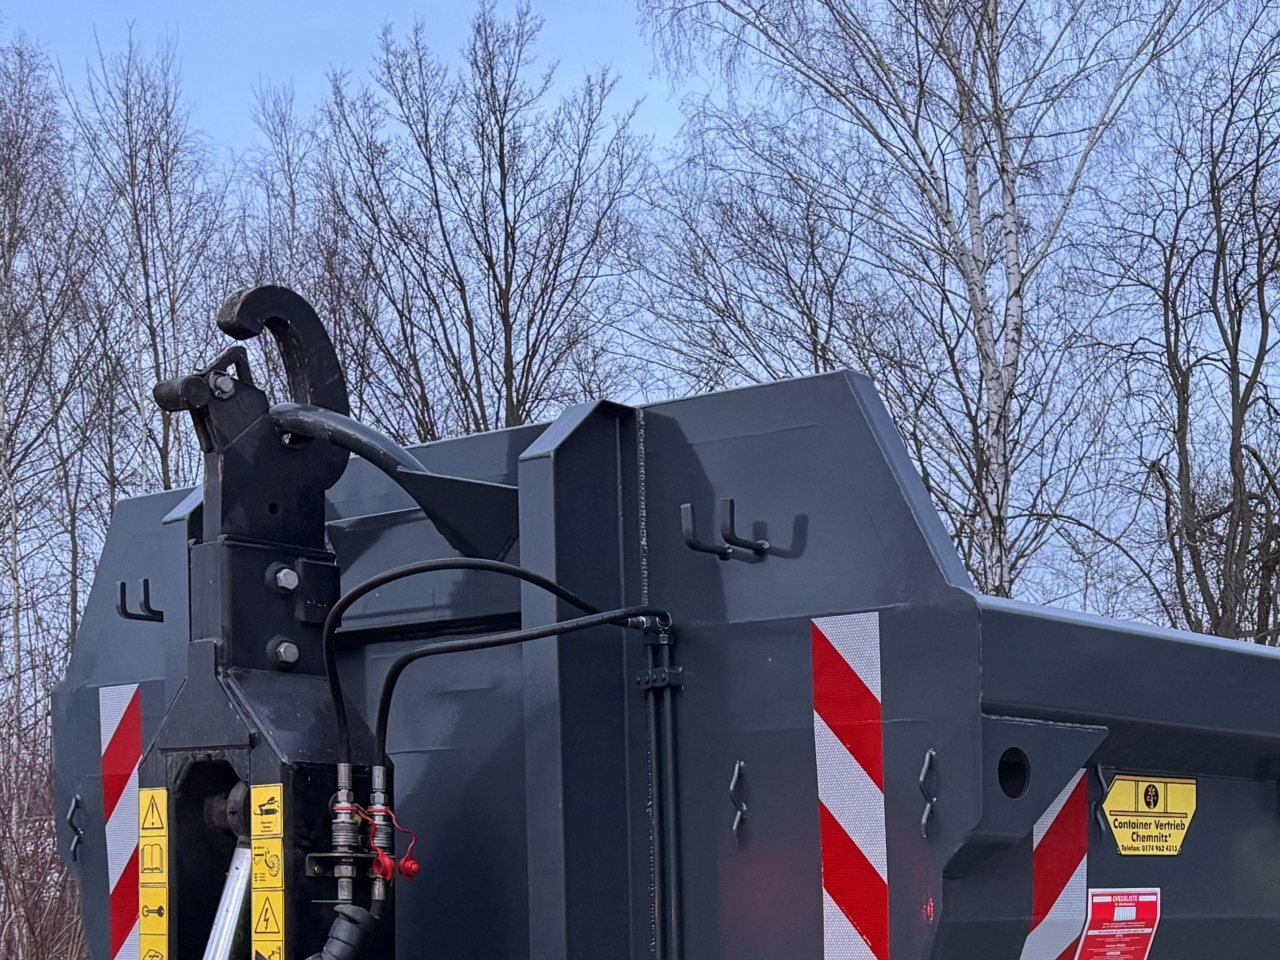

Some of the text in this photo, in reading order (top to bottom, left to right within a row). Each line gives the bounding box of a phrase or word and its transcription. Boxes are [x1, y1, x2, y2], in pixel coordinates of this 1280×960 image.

[1113, 818, 1186, 831] Container Vertrieb
[1121, 844, 1141, 852] Telefon:
